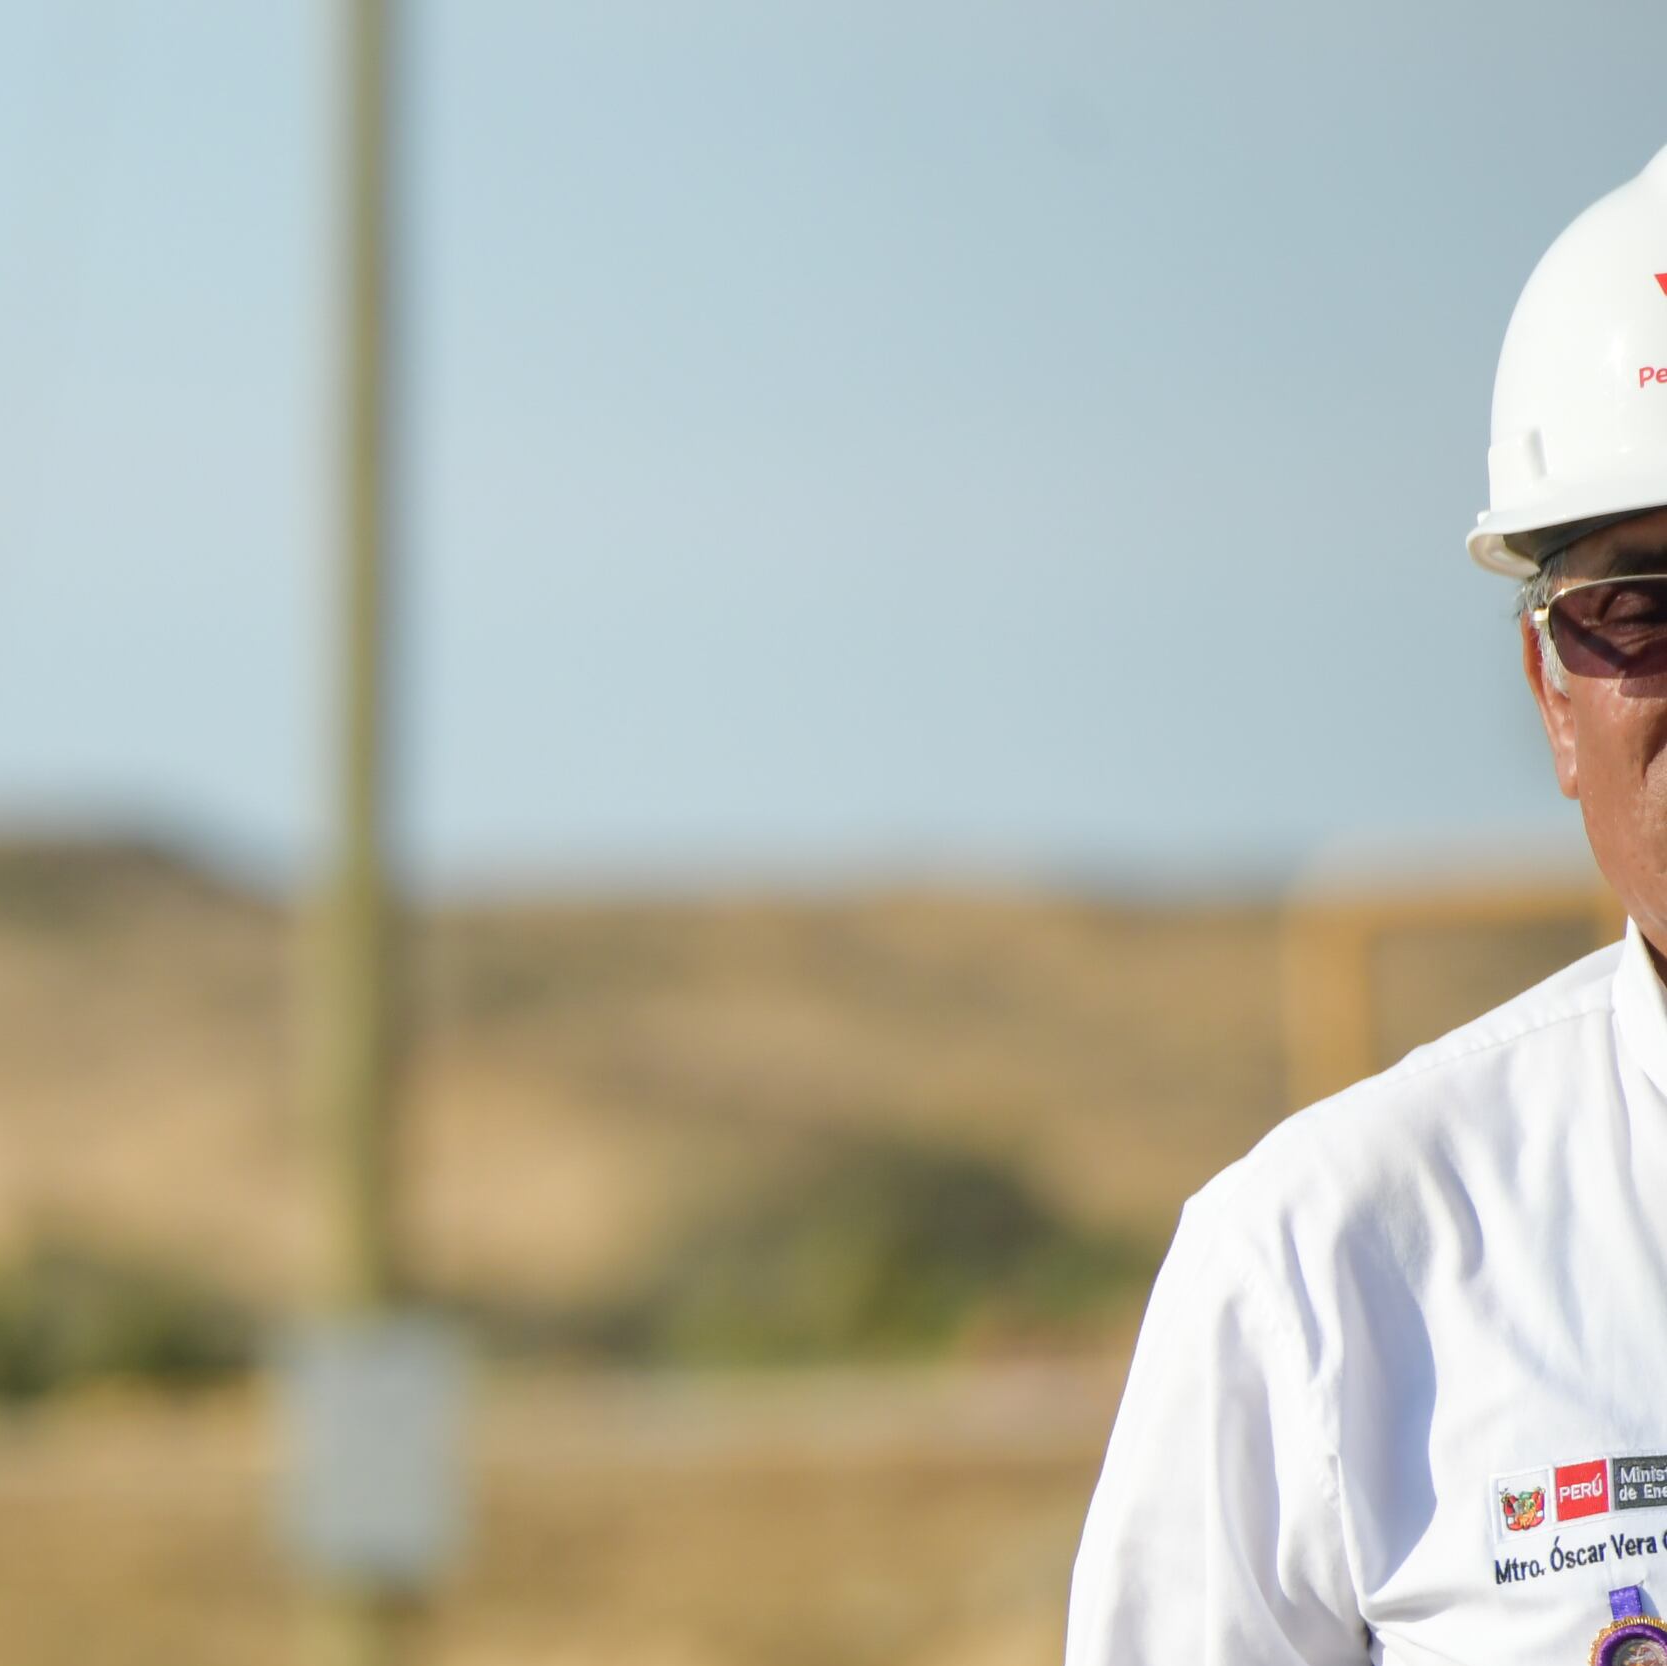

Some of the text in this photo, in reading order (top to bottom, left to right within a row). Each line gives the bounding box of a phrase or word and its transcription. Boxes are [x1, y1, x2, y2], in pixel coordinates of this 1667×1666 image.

[1559, 1472, 1603, 1504] PERÚ
[1618, 1484, 1638, 1502] de
[1494, 1557, 1547, 1585] Mtro.
[1549, 1535, 1607, 1572] Óscar
[1610, 1532, 1658, 1560] Vera
